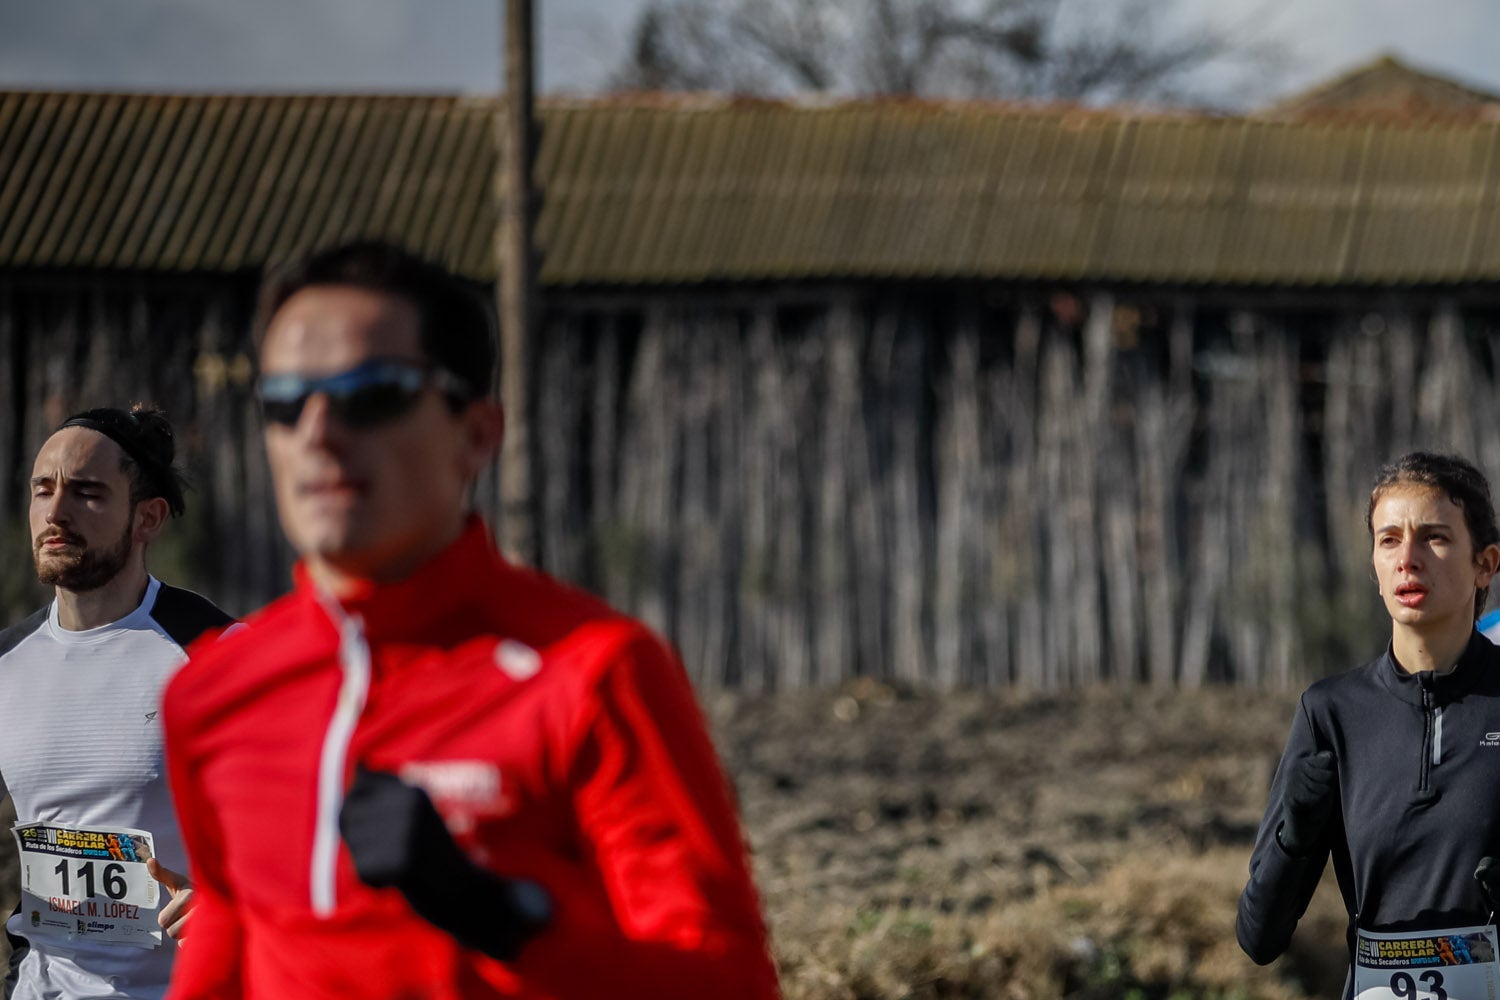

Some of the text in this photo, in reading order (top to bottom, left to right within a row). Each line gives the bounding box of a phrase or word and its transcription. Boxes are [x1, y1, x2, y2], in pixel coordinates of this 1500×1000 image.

[21, 828, 37, 837] 26
[56, 829, 105, 842] CARRERA
[57, 838, 106, 849] POPULAR
[56, 845, 82, 855] Secaderos
[55, 859, 127, 900] 116
[49, 897, 140, 920] ISMAEL M. LÓPEZ
[87, 921, 115, 930] olimpo
[1378, 939, 1435, 950] CARRERA
[1380, 948, 1436, 958] POPULAR
[1378, 958, 1410, 966] Secaderos
